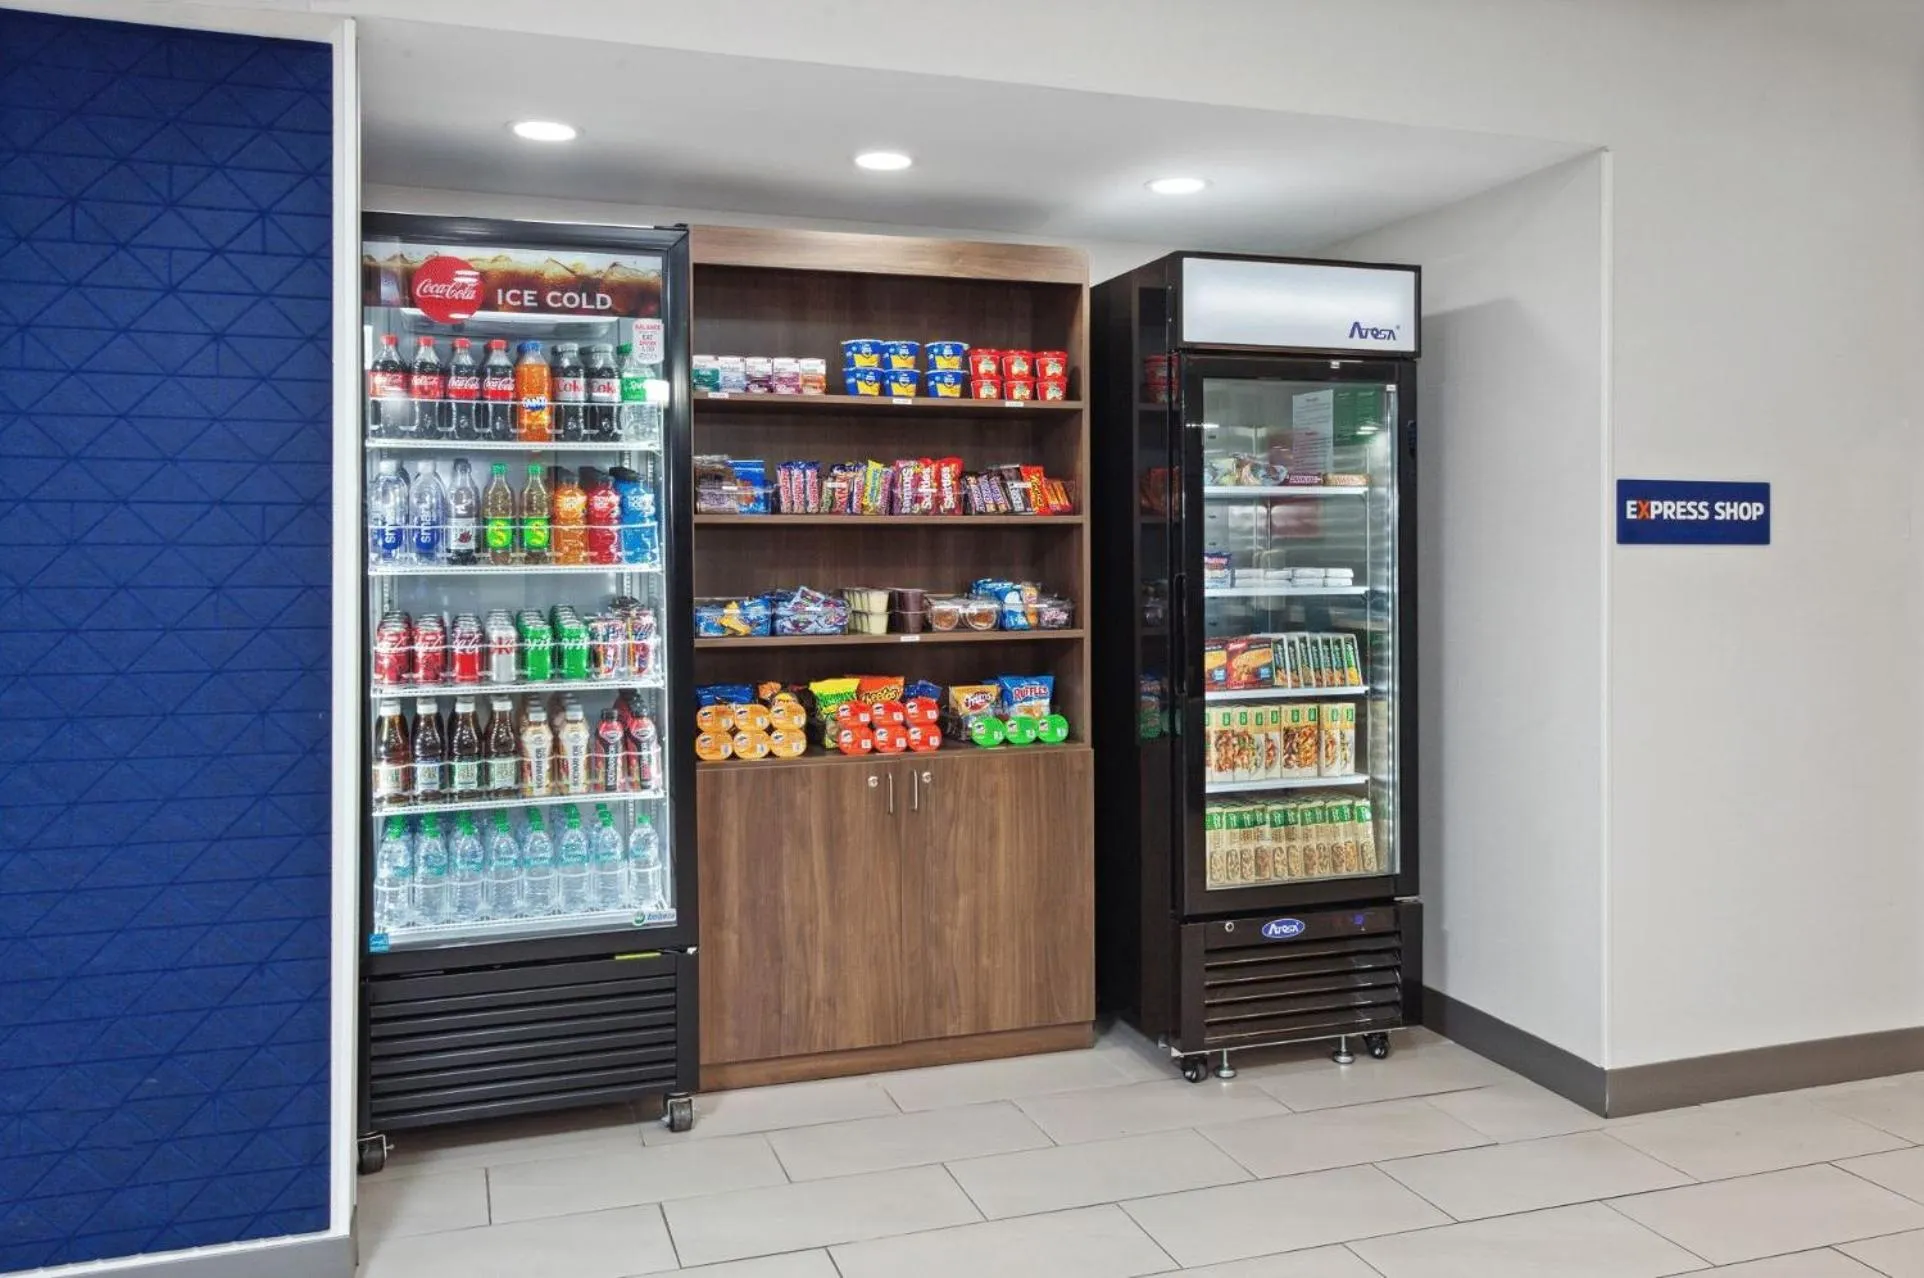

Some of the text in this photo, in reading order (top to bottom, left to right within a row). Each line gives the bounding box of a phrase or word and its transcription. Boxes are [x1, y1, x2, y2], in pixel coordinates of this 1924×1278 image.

[415, 278, 478, 300] Coca-Cola
[497, 288, 613, 310] ICE COLD
[1626, 499, 1765, 521] EXPRESS SHOP
